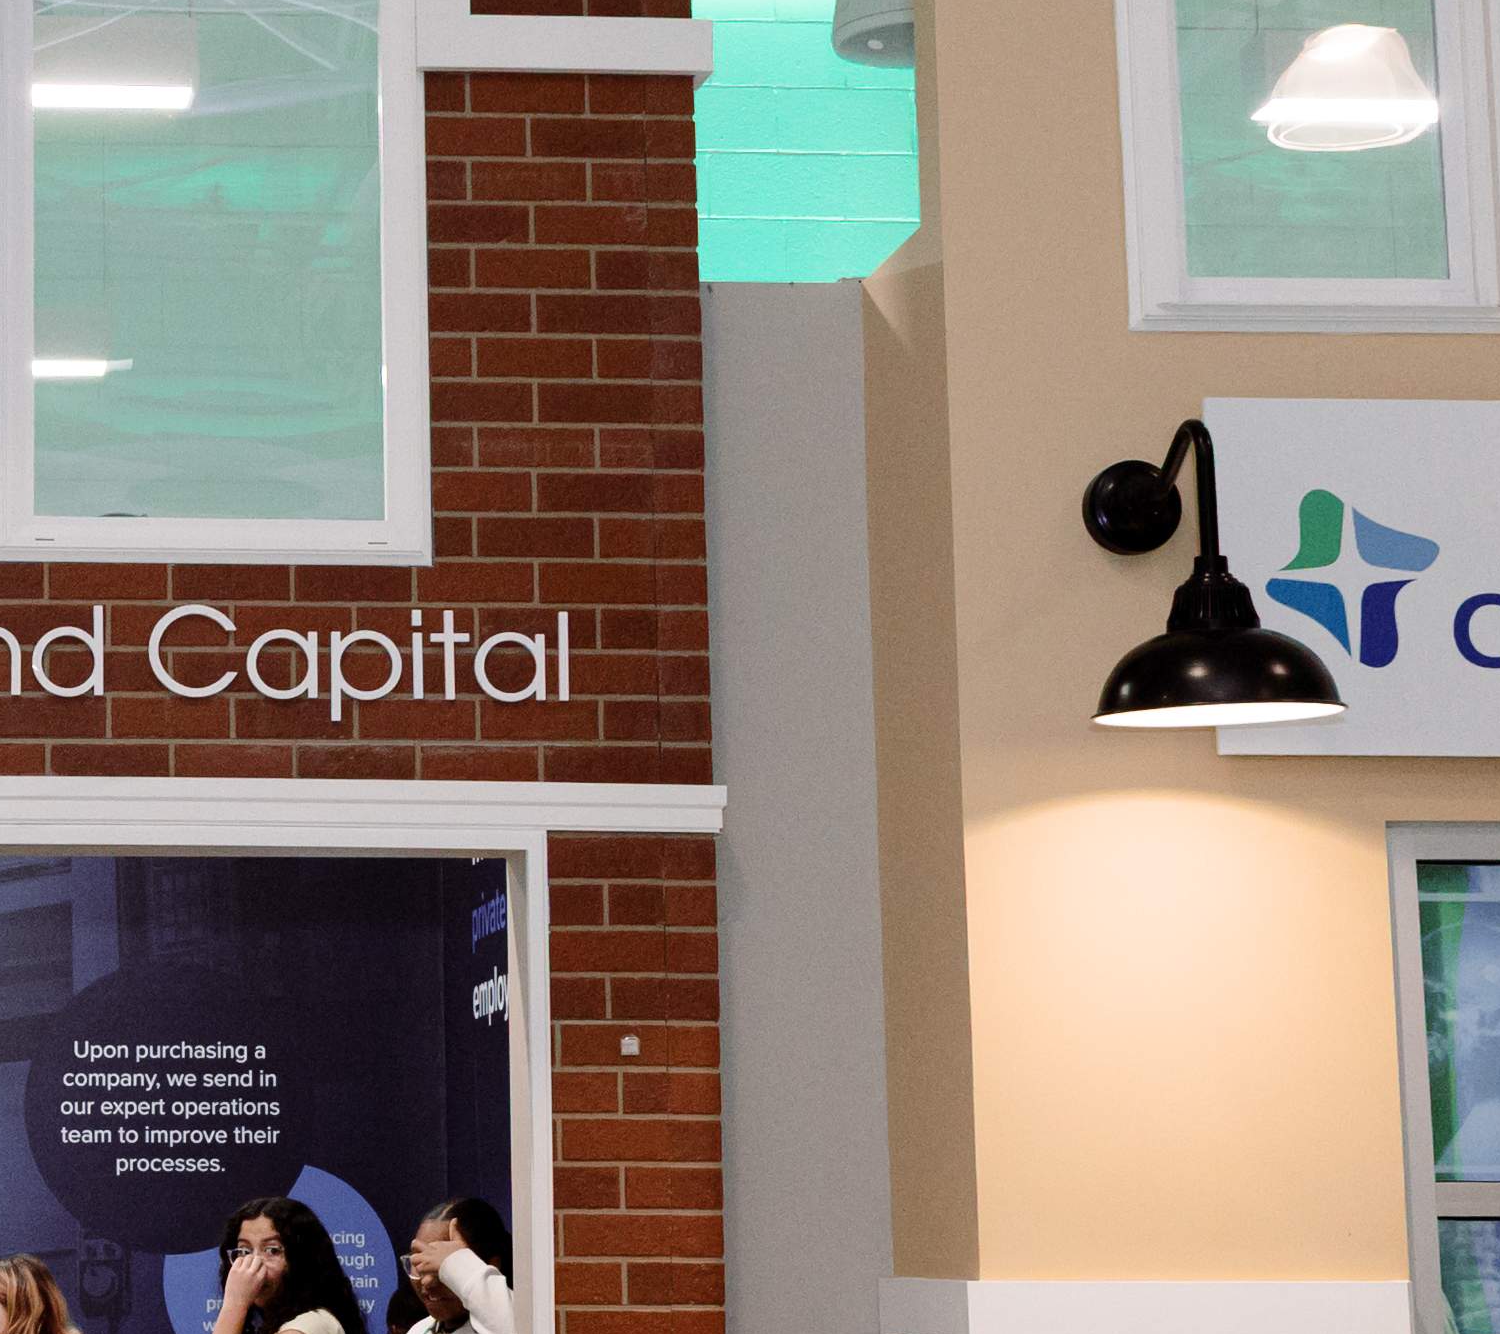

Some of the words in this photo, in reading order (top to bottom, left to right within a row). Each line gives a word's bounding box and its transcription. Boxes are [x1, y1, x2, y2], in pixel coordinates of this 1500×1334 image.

[146, 602, 571, 724] Capital
[471, 890, 506, 954] private
[72, 1040, 129, 1064] Upon
[135, 1040, 249, 1065] purchasing
[254, 1045, 267, 1060] a
[62, 1069, 161, 1091] company,
[166, 1073, 197, 1088] we
[202, 1068, 253, 1088] send
[259, 1069, 278, 1088] in
[60, 1100, 95, 1116] our
[100, 1097, 166, 1120] expert
[171, 1097, 281, 1121] operations
[60, 1126, 112, 1145] team
[117, 1126, 139, 1145] to
[144, 1125, 229, 1149] improve
[232, 1124, 281, 1145] their
[115, 1157, 227, 1178] processes.
